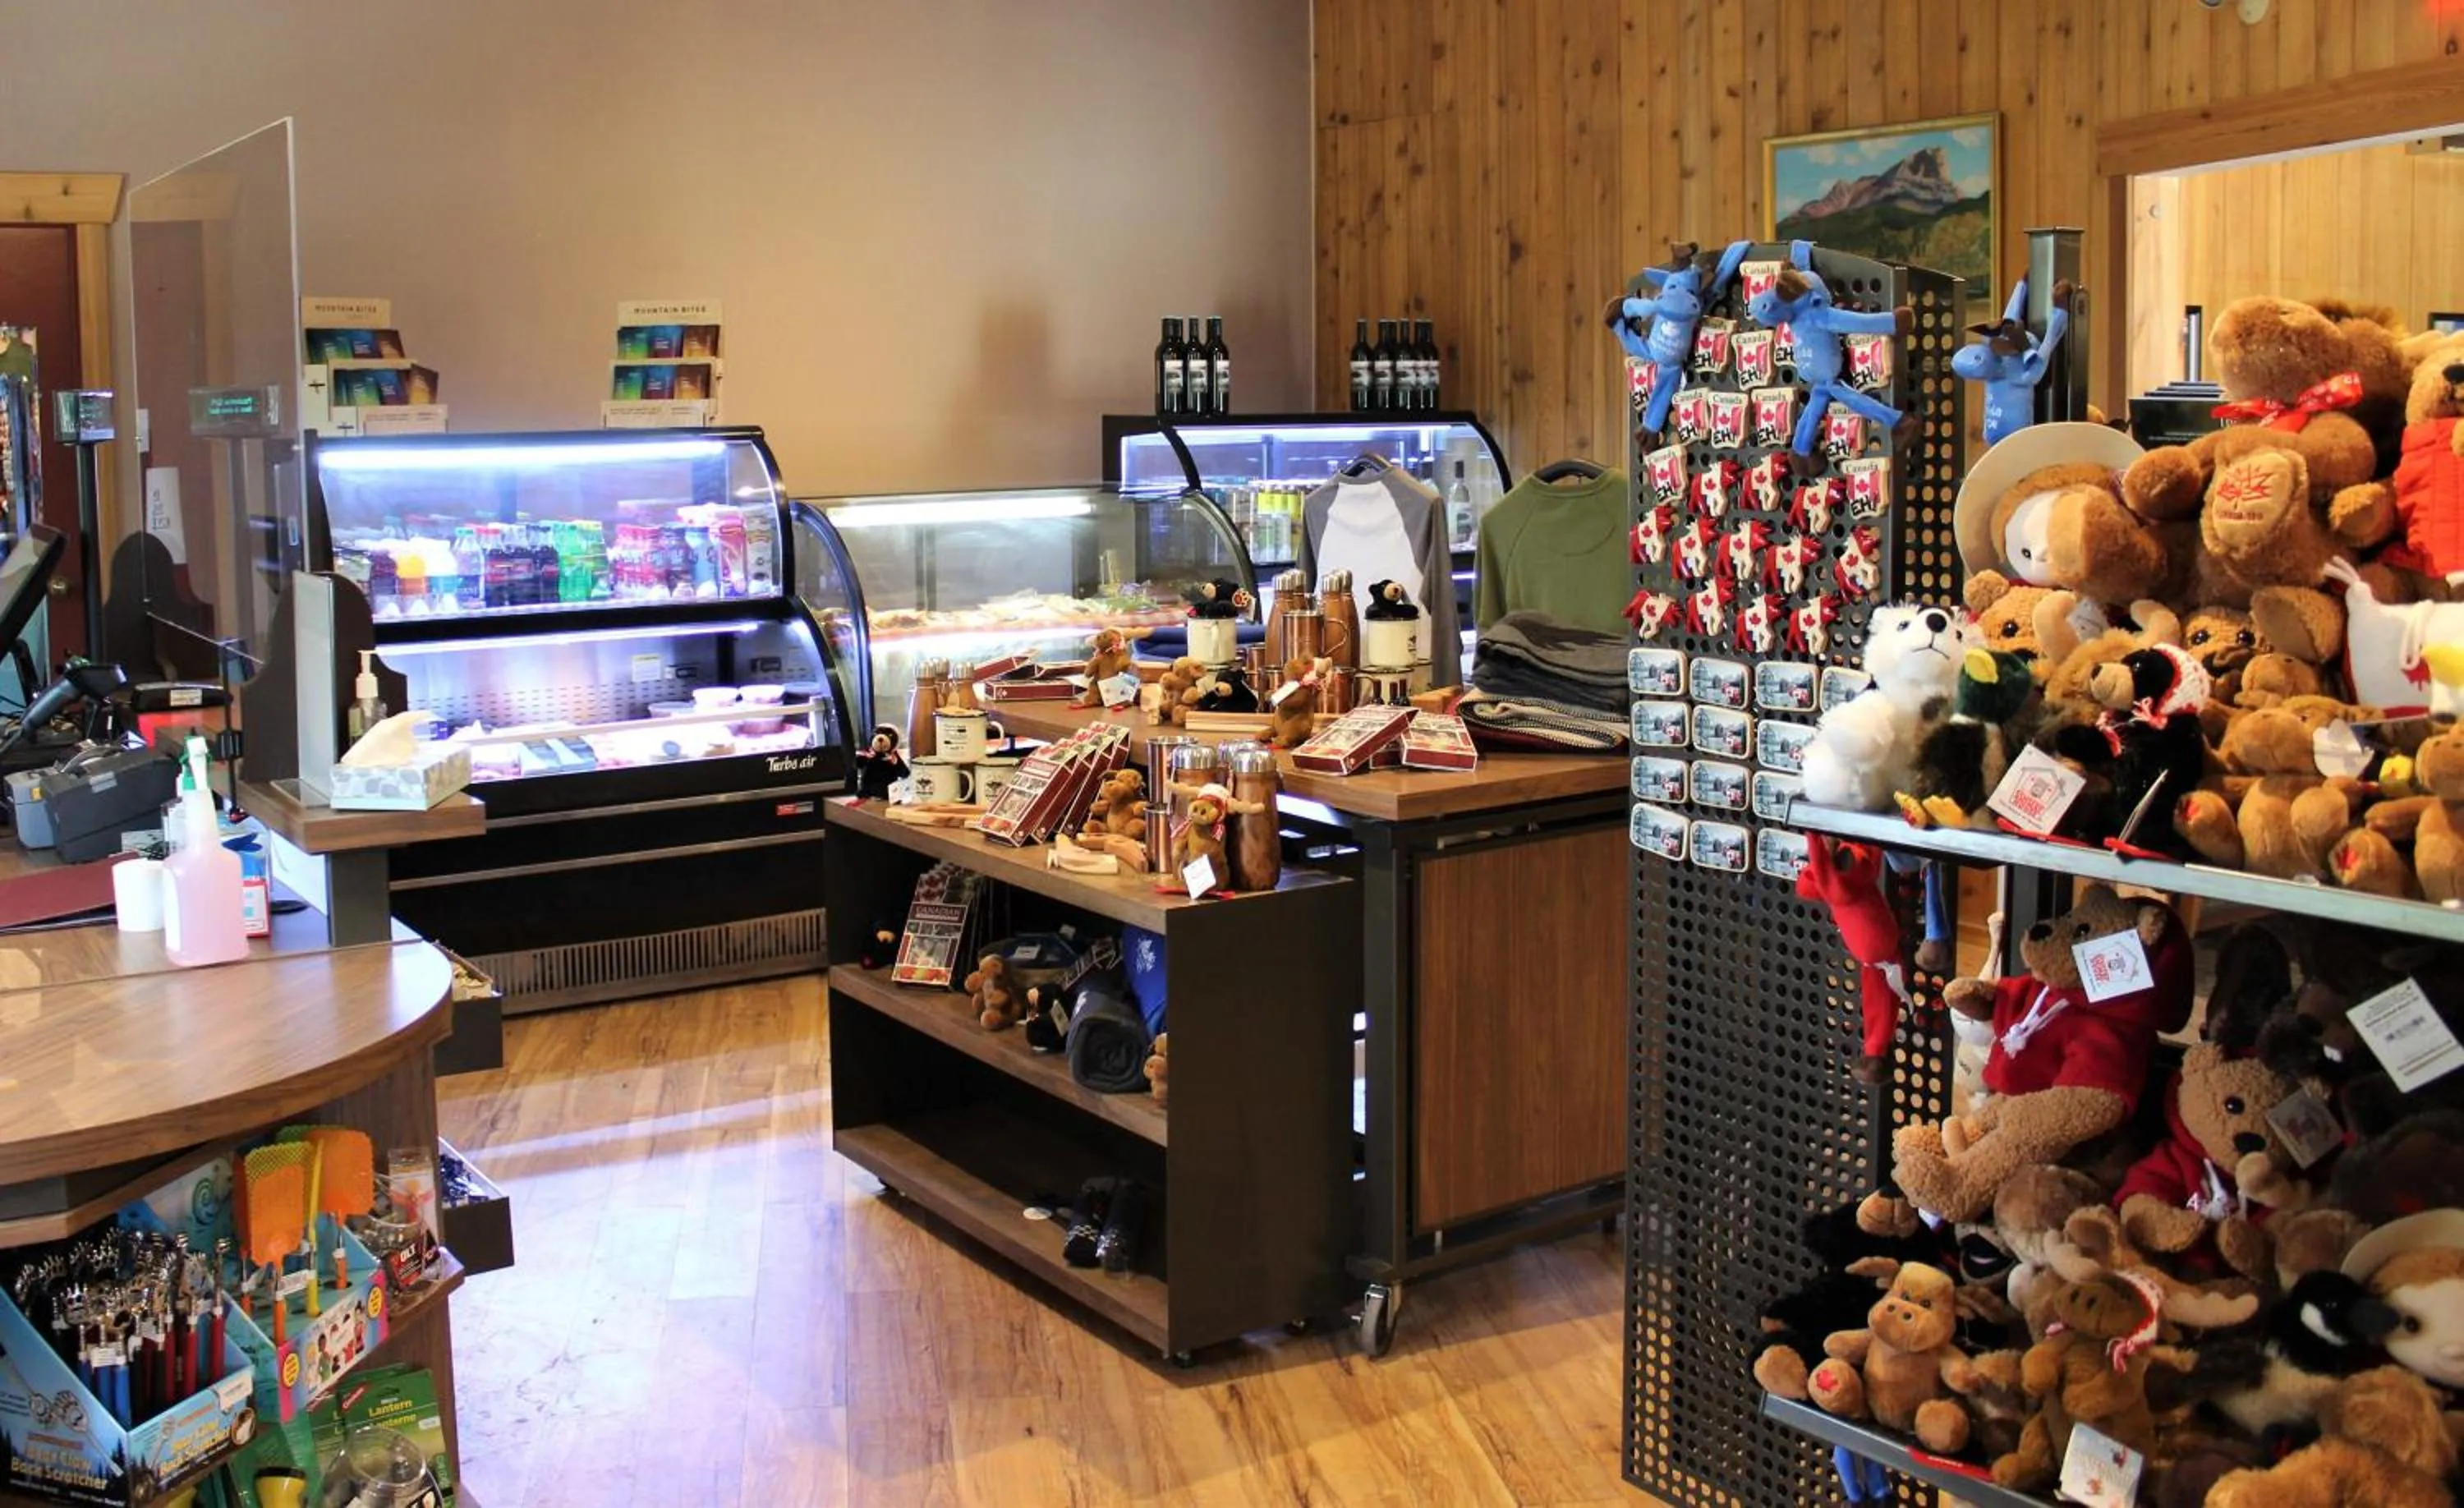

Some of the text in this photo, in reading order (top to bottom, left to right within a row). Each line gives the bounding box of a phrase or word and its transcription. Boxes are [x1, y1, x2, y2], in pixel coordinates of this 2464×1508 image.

[1735, 332, 1767, 343] Canada
[1754, 392, 1786, 402] Canada
[1846, 462, 1879, 473] Canada
[765, 754, 817, 773] Turbo air
[368, 1399, 413, 1418] Lantern
[10, 1455, 44, 1474] Back
[46, 1464, 108, 1490] Scratcher
